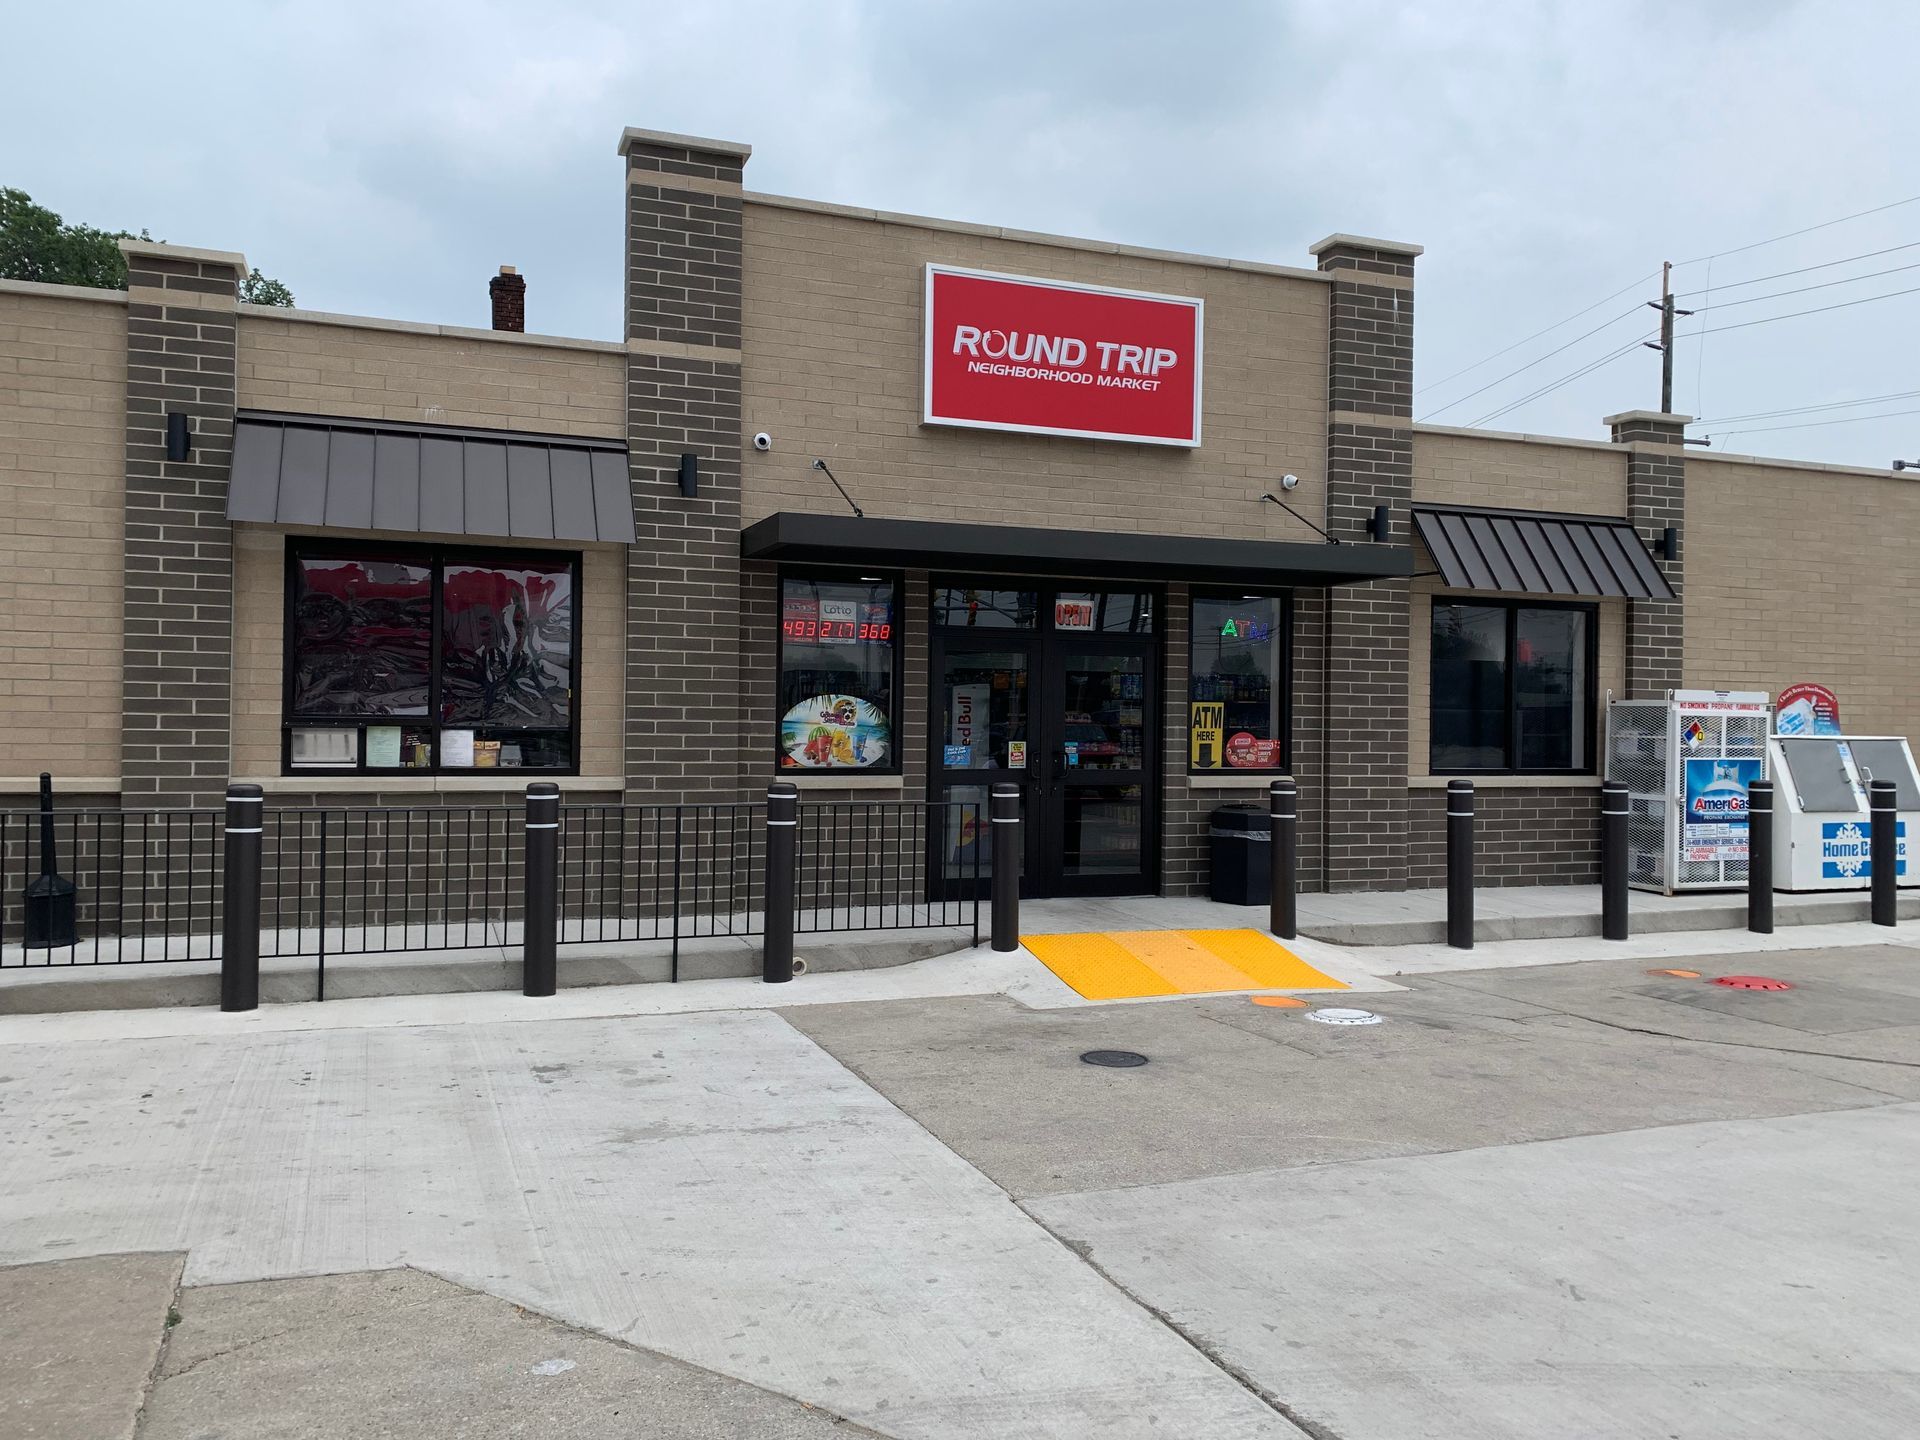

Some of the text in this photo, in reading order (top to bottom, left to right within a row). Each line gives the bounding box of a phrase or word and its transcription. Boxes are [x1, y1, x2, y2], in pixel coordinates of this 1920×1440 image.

[953, 325, 1178, 377] ROUND TRIP
[967, 361, 1161, 392] NEIGHBORHOOD MARKET
[1056, 604, 1092, 627] OPEN
[783, 621, 816, 636] 493
[859, 624, 890, 639] 368
[1221, 618, 1269, 640] ATM
[957, 696, 972, 725] Bull
[1192, 706, 1222, 729] ATM
[1196, 731, 1215, 741] HERE
[1697, 731, 1704, 741] 0
[1694, 797, 1750, 811] AmeriGas
[1823, 842, 1859, 857] Home
